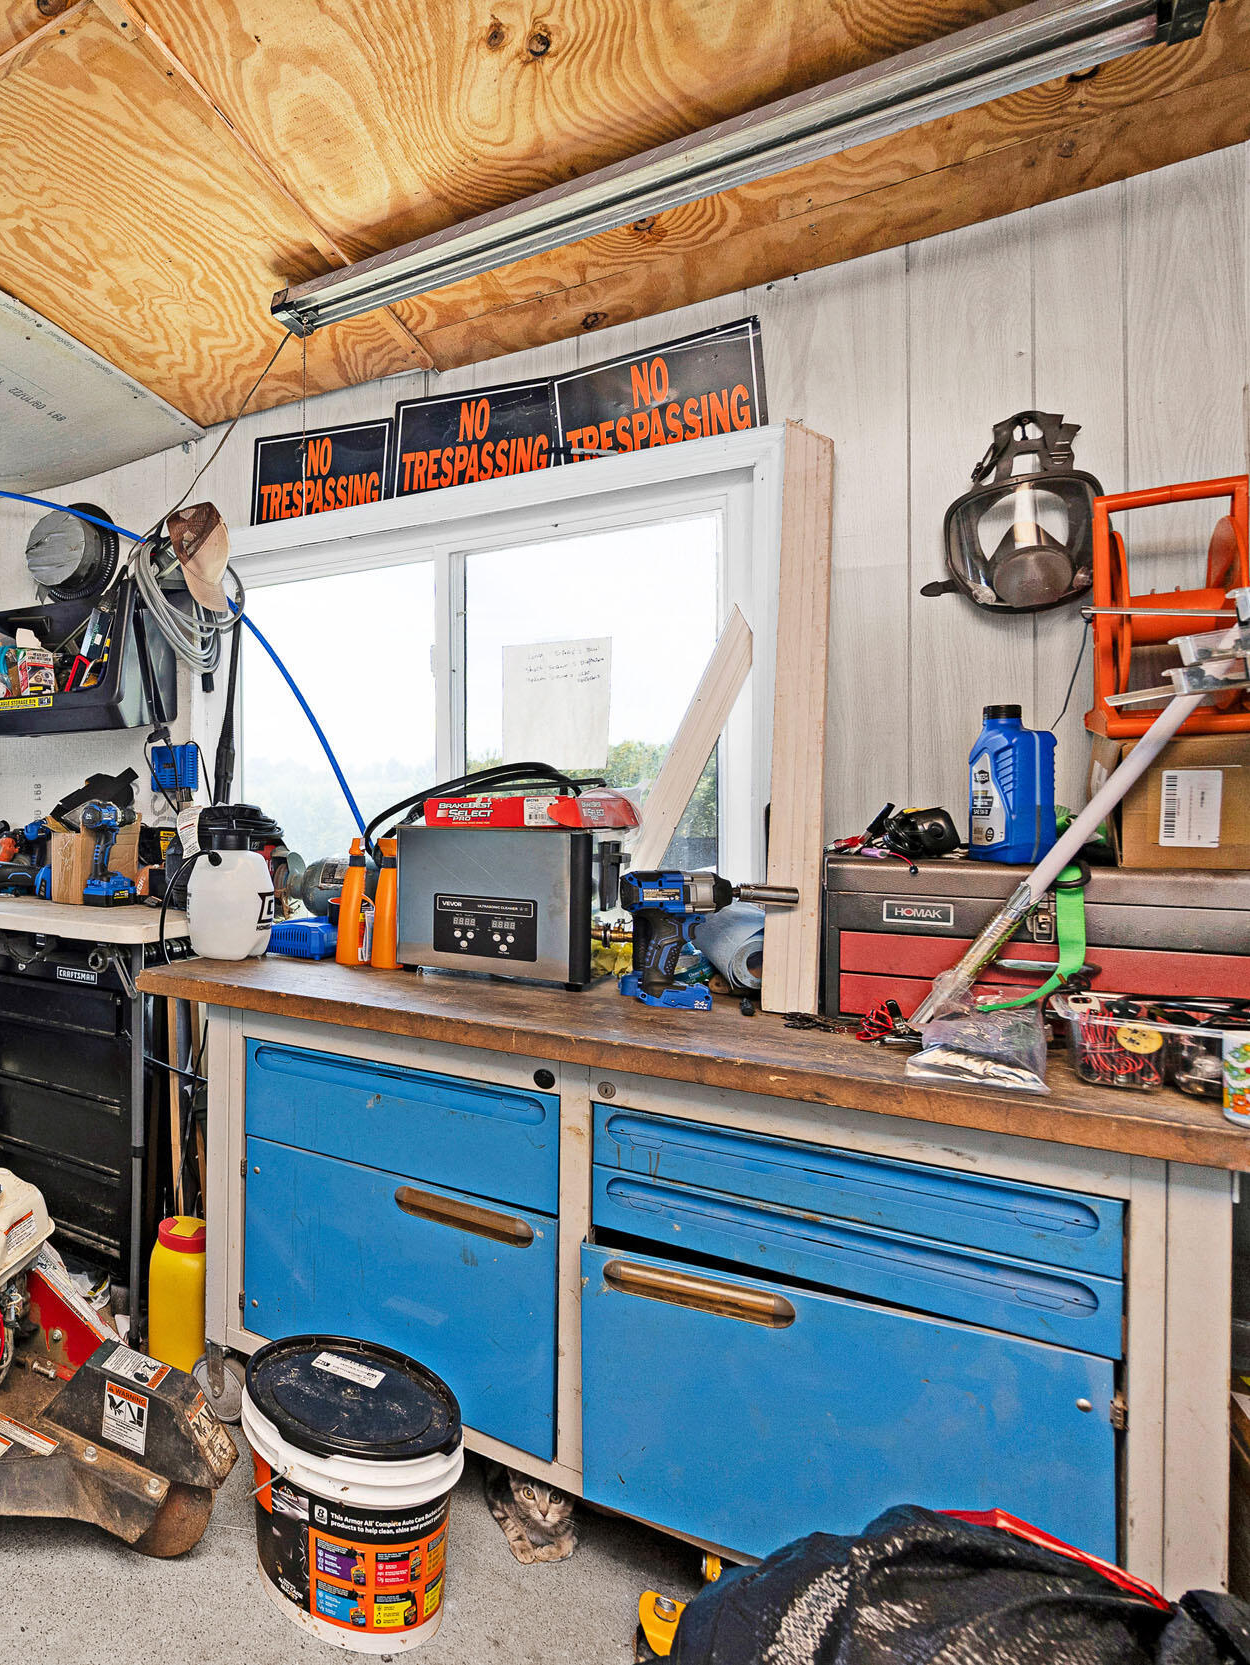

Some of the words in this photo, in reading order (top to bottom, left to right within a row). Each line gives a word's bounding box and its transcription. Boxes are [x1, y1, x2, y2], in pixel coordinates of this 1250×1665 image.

[632, 357, 670, 408] NO
[459, 398, 490, 442] NO
[566, 384, 751, 459] TRESPASSING
[307, 437, 332, 476] NO
[402, 437, 549, 491] TRESPASSING
[260, 472, 380, 521] TRESPASSING
[448, 809, 493, 817] SELECT
[895, 907, 942, 918] HOMAK
[59, 969, 95, 982] CRAFTSMAN
[115, 1388, 146, 1405] WARNING
[318, 1509, 325, 1518] 8
[331, 1512, 343, 1521] This
[344, 1516, 363, 1526] Armor
[402, 1518, 414, 1526] Auto
[415, 1515, 425, 1523] Care
[331, 1520, 357, 1531] products
[365, 1526, 378, 1535] help
[410, 1523, 419, 1531] and
